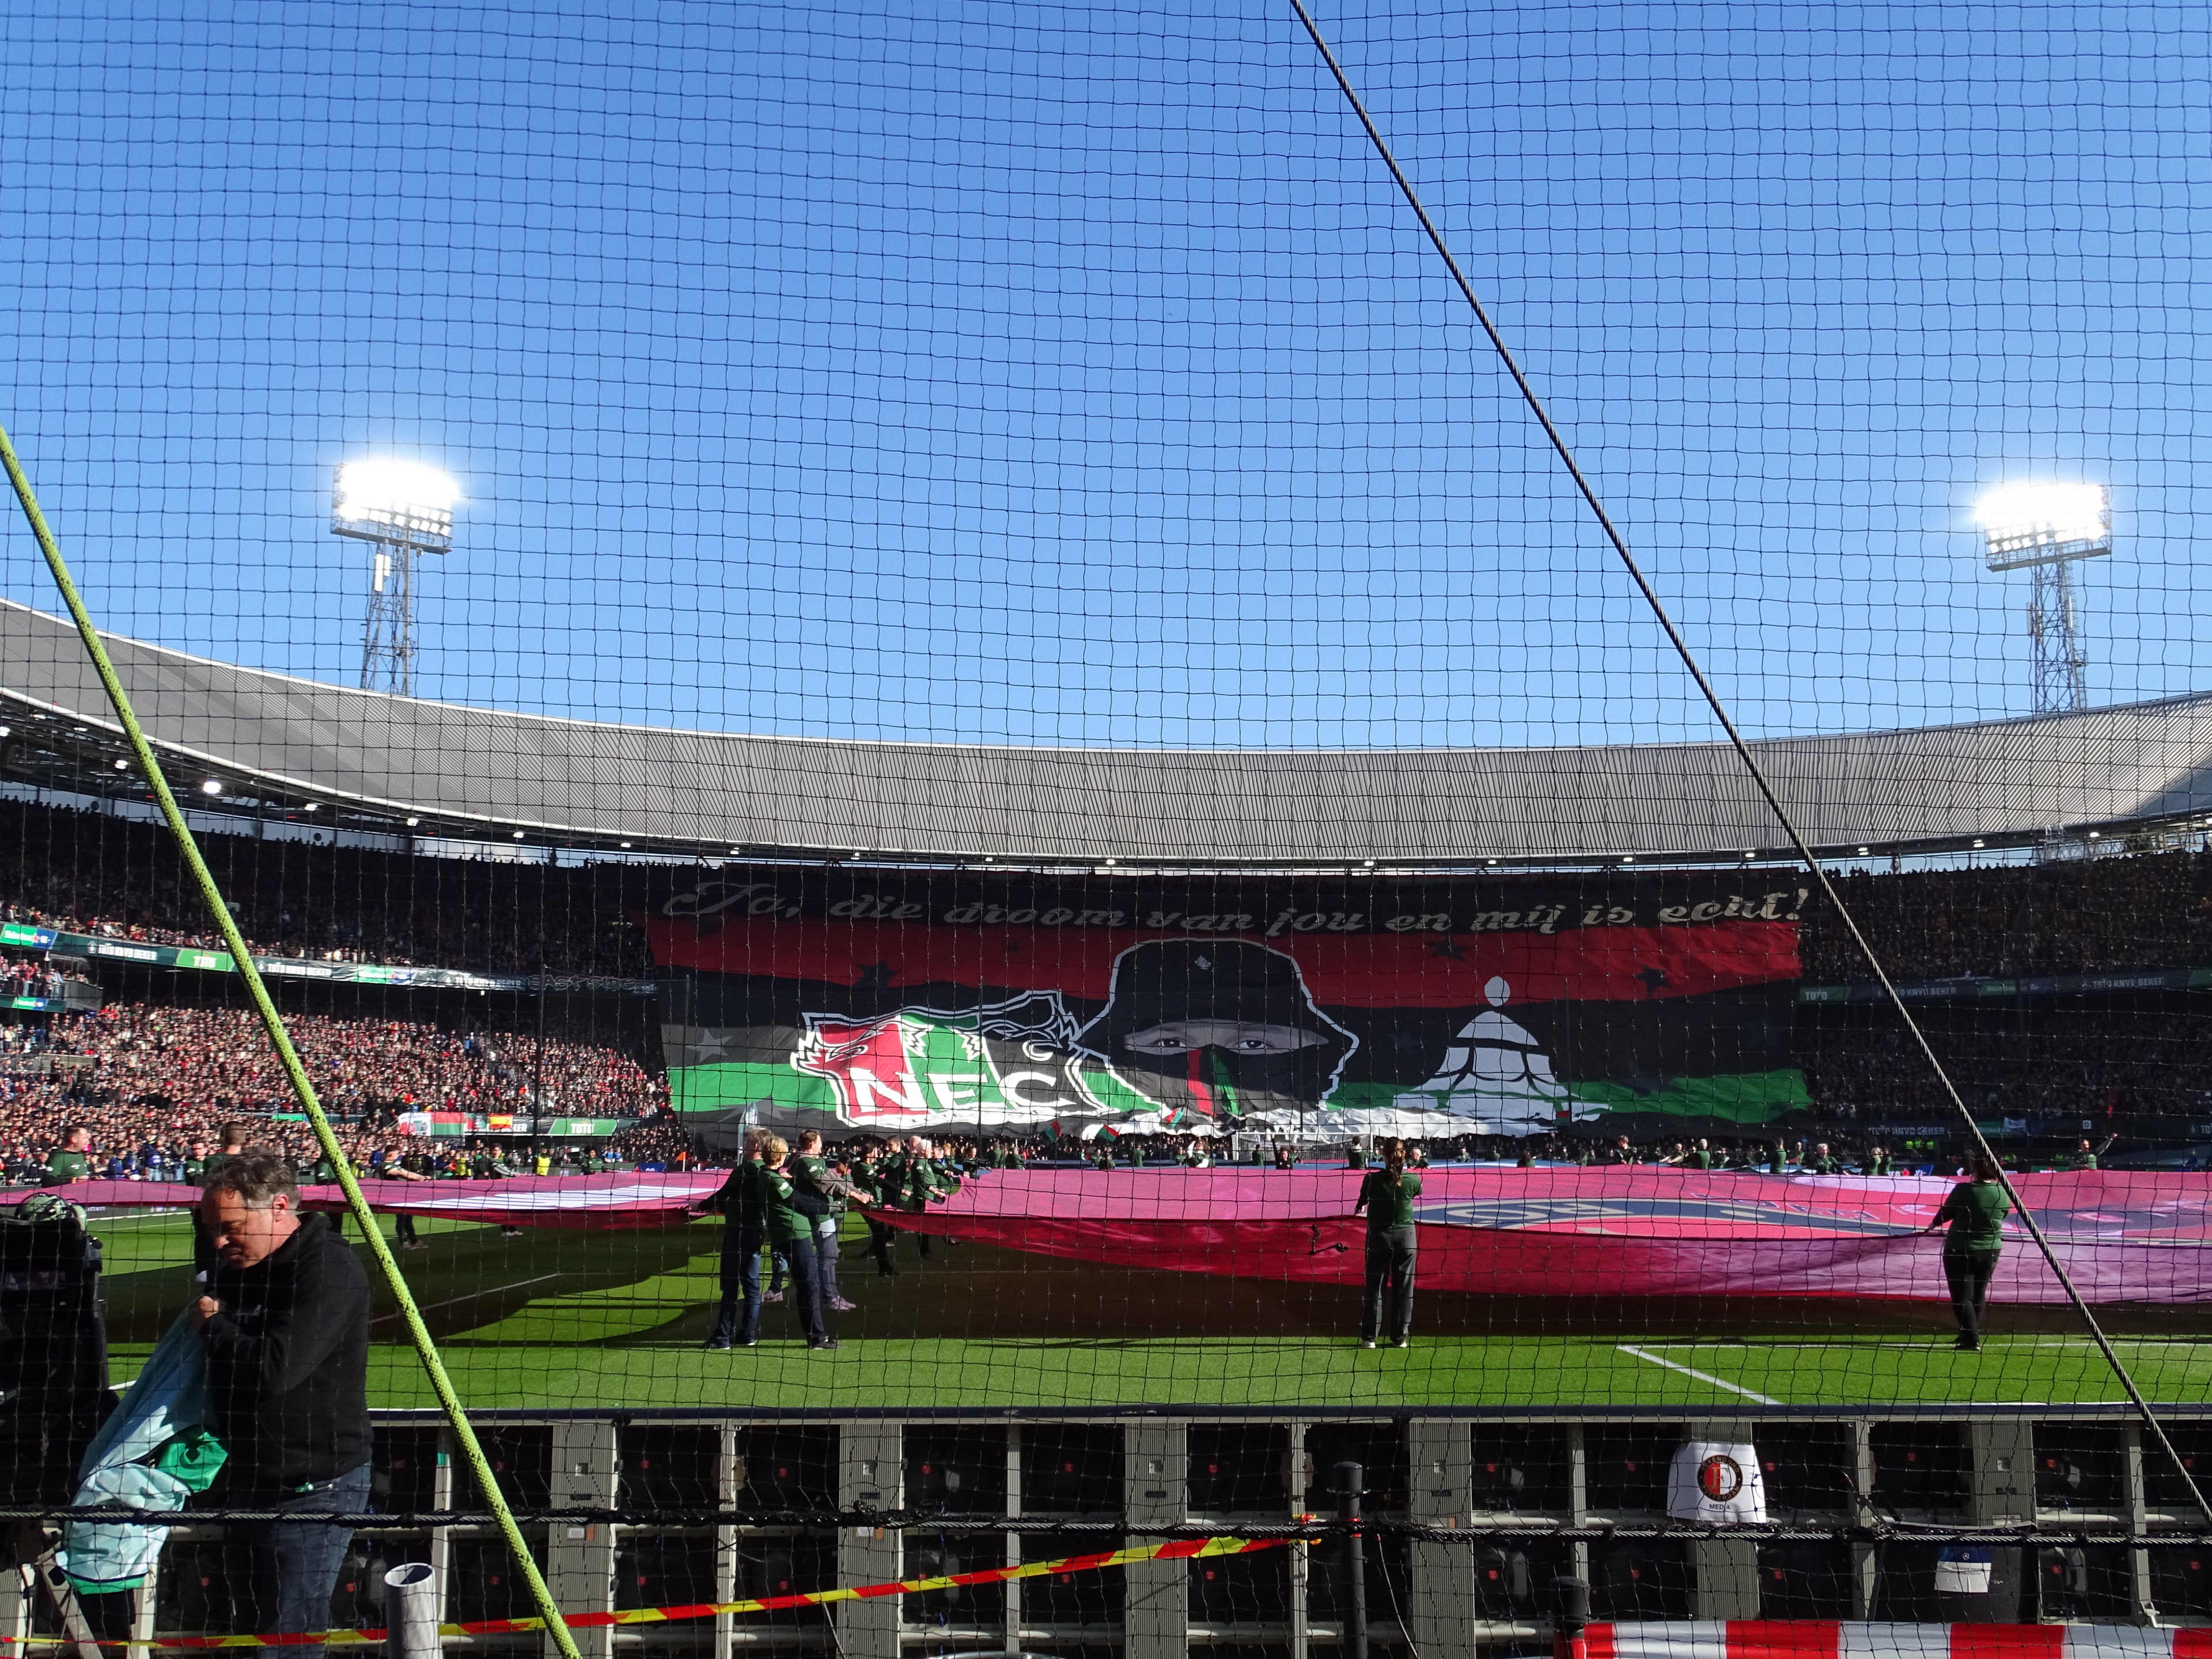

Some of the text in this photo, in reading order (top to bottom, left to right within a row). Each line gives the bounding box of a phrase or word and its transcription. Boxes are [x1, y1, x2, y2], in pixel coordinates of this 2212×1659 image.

[662, 881, 1809, 937] Ja, die droom van jou en mij is echt!
[134, 949, 157, 961] BEKER
[306, 967, 332, 976] BEKER
[2092, 980, 2112, 988] TOTO
[2113, 979, 2135, 987] KNVB
[1804, 991, 1828, 1001] TOTO
[1930, 987, 1956, 995] BEKER
[846, 1067, 1077, 1113] NEC
[570, 1123, 596, 1134] TOTO
